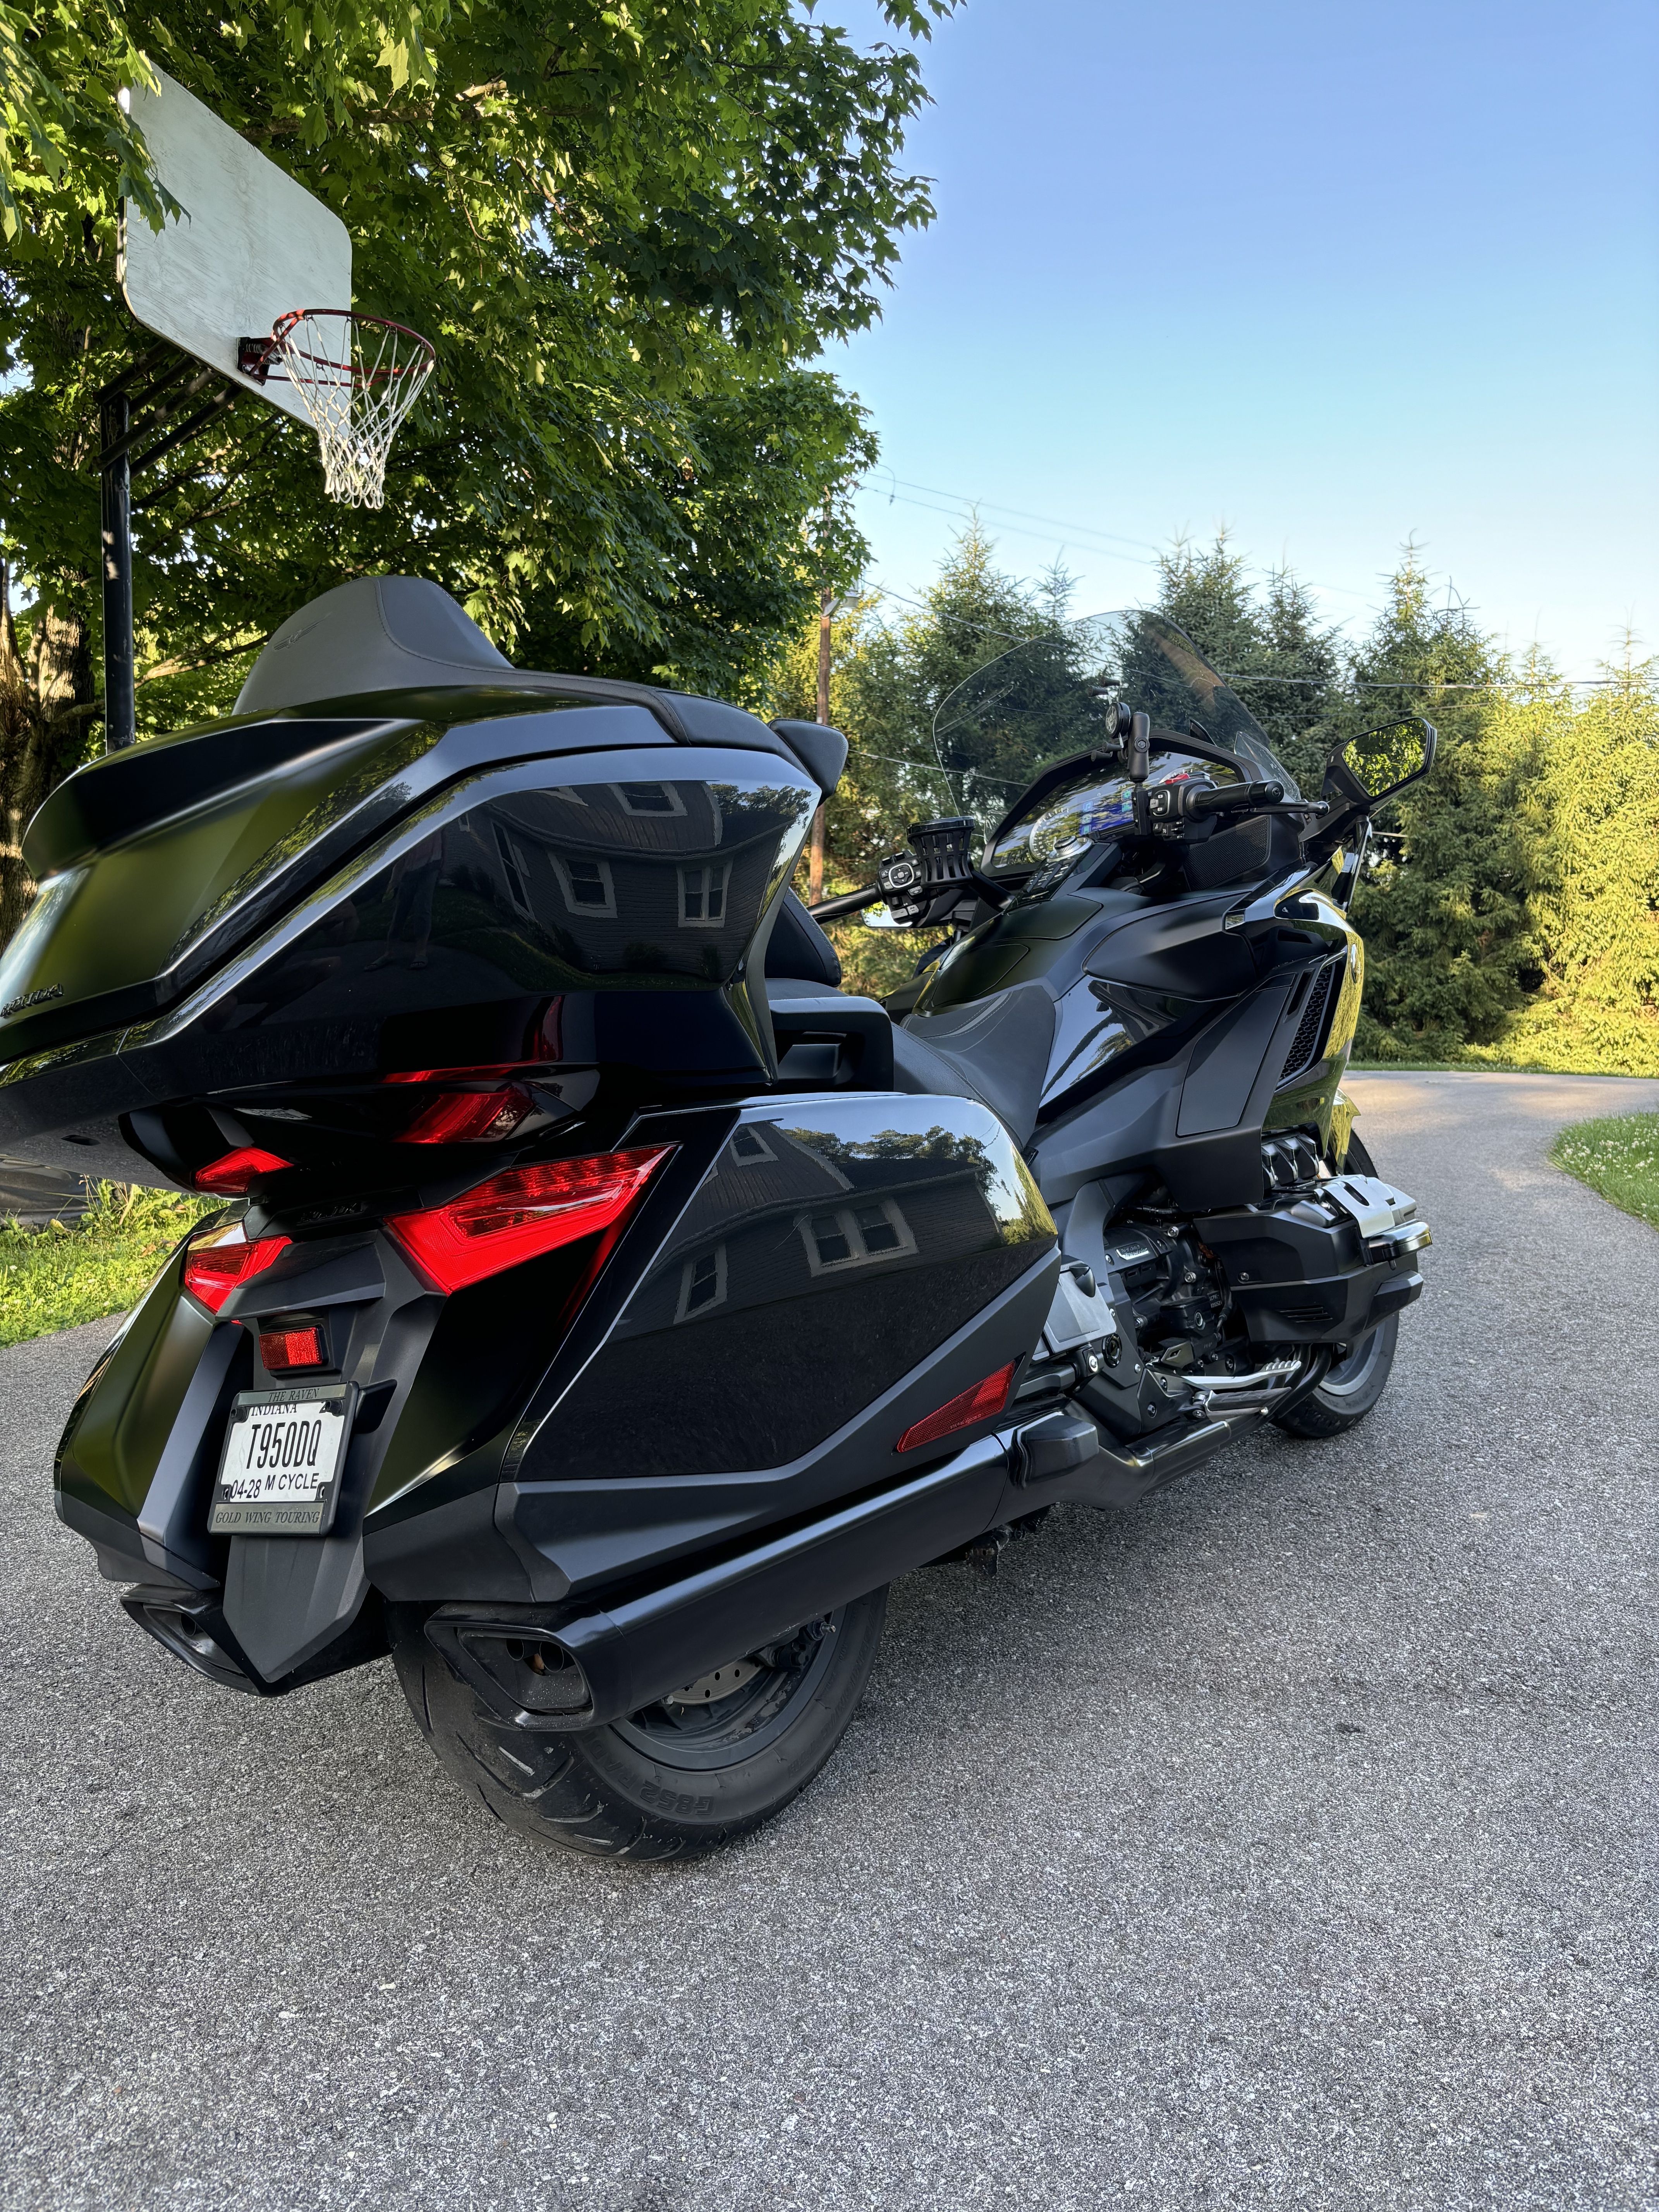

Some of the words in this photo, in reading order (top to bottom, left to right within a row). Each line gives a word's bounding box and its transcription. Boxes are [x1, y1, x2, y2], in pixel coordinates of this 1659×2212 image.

[268, 1391, 287, 1402] THE
[288, 1388, 320, 1401] RAVEN
[251, 1403, 297, 1416] INDIANA
[246, 1419, 322, 1469] T950DQ
[231, 1479, 262, 1499] 04-28
[264, 1475, 276, 1491] M
[278, 1473, 319, 1490] CYCLE
[216, 1512, 242, 1523] GOLD
[245, 1511, 272, 1523] WING
[275, 1511, 320, 1523] TOURING
[582, 1730, 641, 1790] RADI
[639, 1780, 716, 1815] G852
